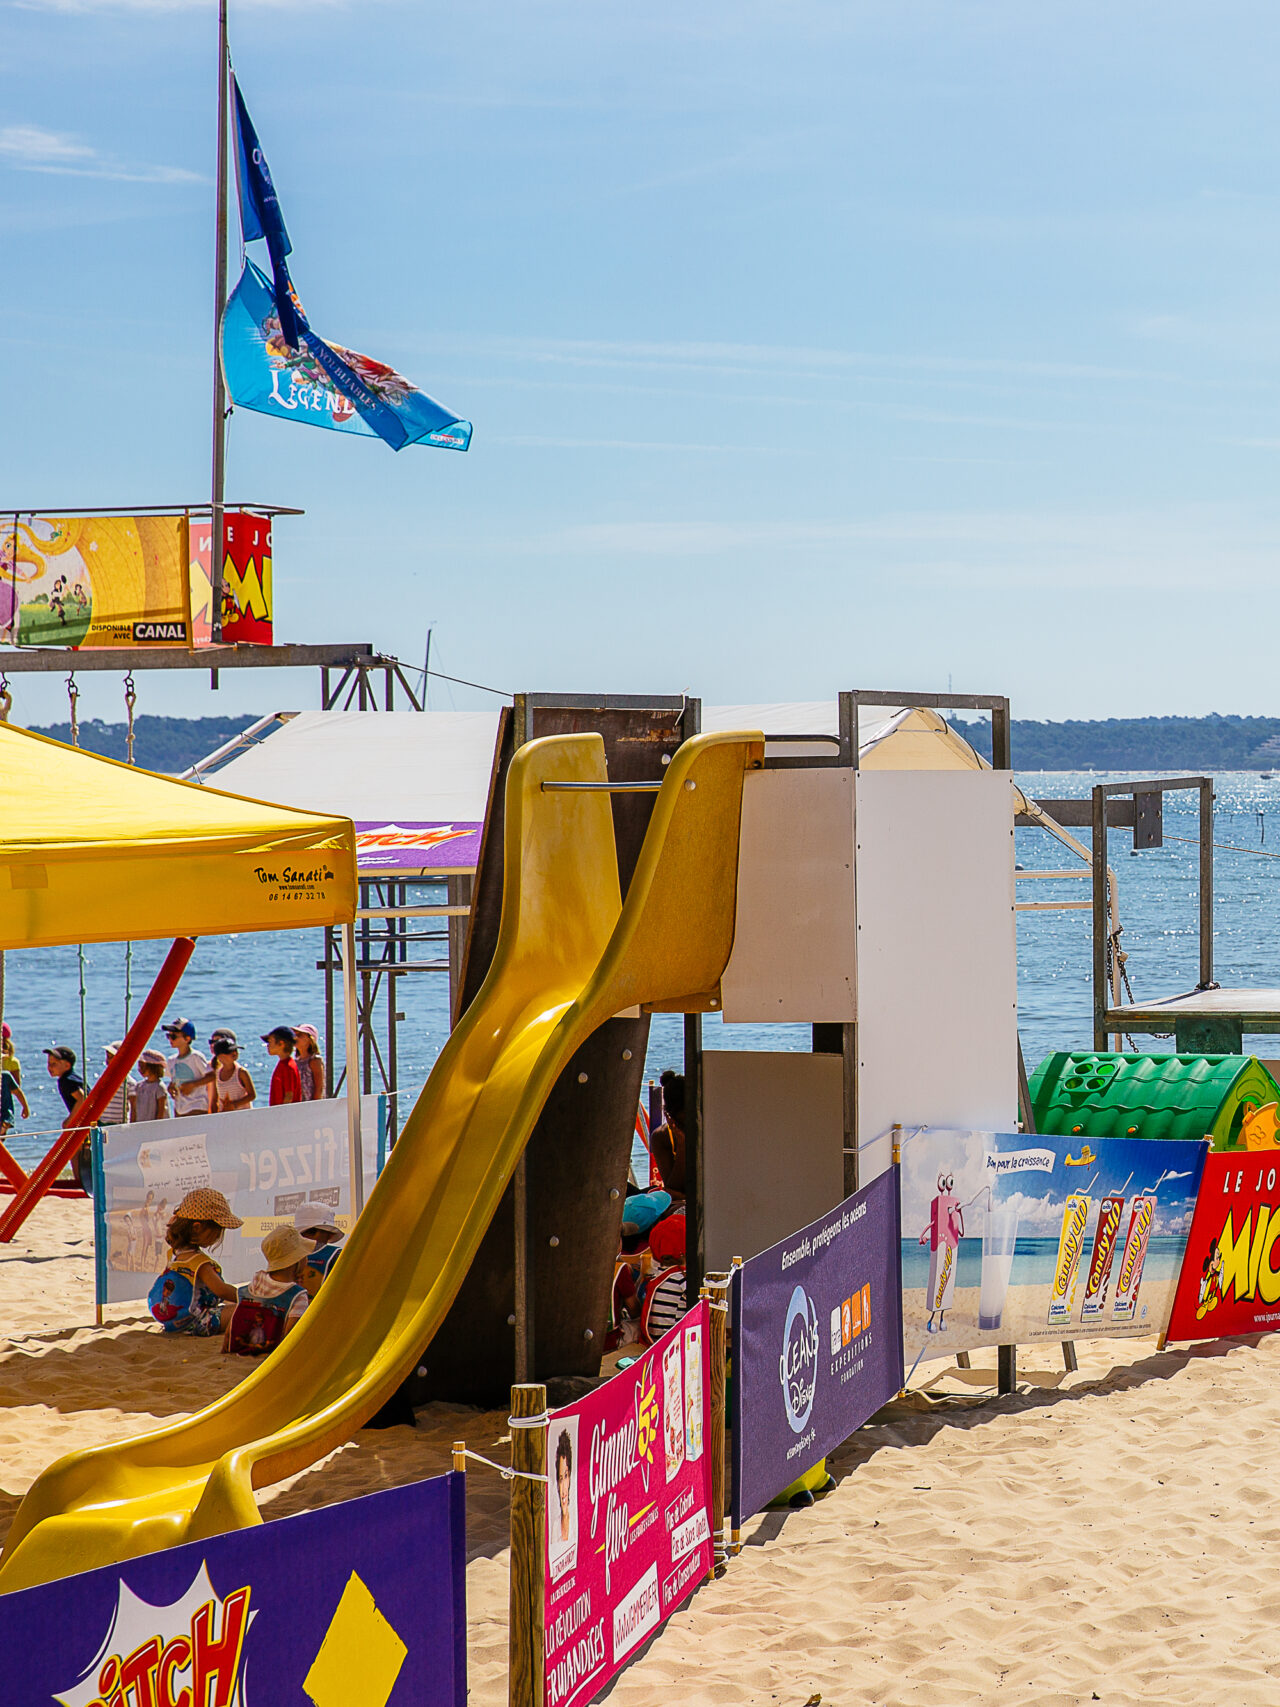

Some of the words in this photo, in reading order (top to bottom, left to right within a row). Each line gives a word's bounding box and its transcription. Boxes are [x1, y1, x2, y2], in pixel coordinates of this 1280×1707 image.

[92, 624, 131, 632] DISPONIBLE
[135, 624, 185, 639] CANAL
[254, 867, 279, 883] Tom
[282, 866, 322, 883] Sanati
[268, 893, 279, 901] 06
[306, 892, 315, 900] 32
[986, 1155, 997, 1169] Bon
[997, 1160, 1010, 1173] pour
[1010, 1157, 1017, 1169] la
[1017, 1156, 1050, 1168] croissance
[1223, 1171, 1243, 1193] LE
[782, 1236, 812, 1271] Ensemble,
[812, 1219, 842, 1256] protégeons
[841, 1211, 850, 1230] les
[830, 1331, 873, 1376] EXPEDITIONS
[840, 1358, 865, 1386] FONDATION
[589, 1418, 640, 1540] Gimme
[605, 1492, 629, 1596] five
[680, 1532, 684, 1551] de
